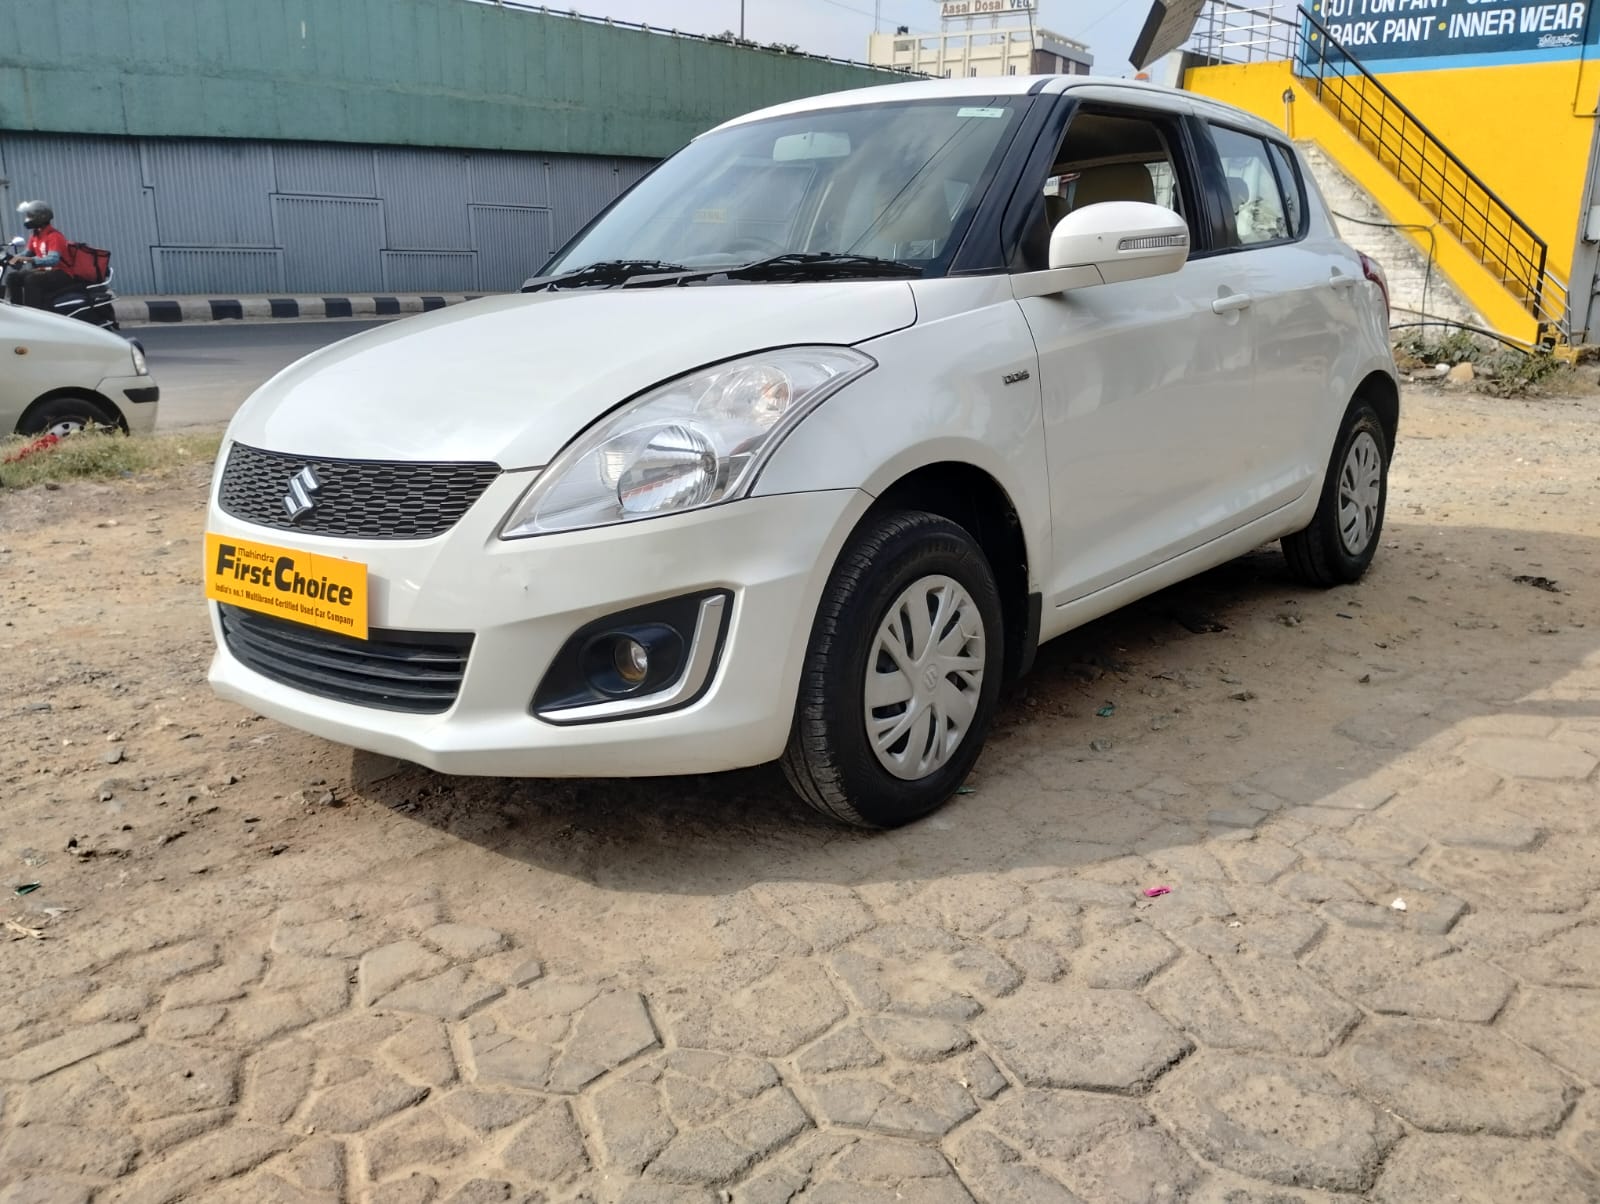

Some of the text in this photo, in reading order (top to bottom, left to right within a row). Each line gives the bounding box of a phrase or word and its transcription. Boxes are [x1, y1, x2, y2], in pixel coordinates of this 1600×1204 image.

[1325, 2, 1586, 47] RACK PANT INNER WEAR
[238, 547, 275, 563] Mahindra
[215, 583, 232, 595] India's
[245, 590, 274, 605] Multibrand
[275, 598, 299, 612] Certified
[300, 603, 314, 615] Used
[315, 607, 326, 618] Car
[327, 610, 354, 627] Company
